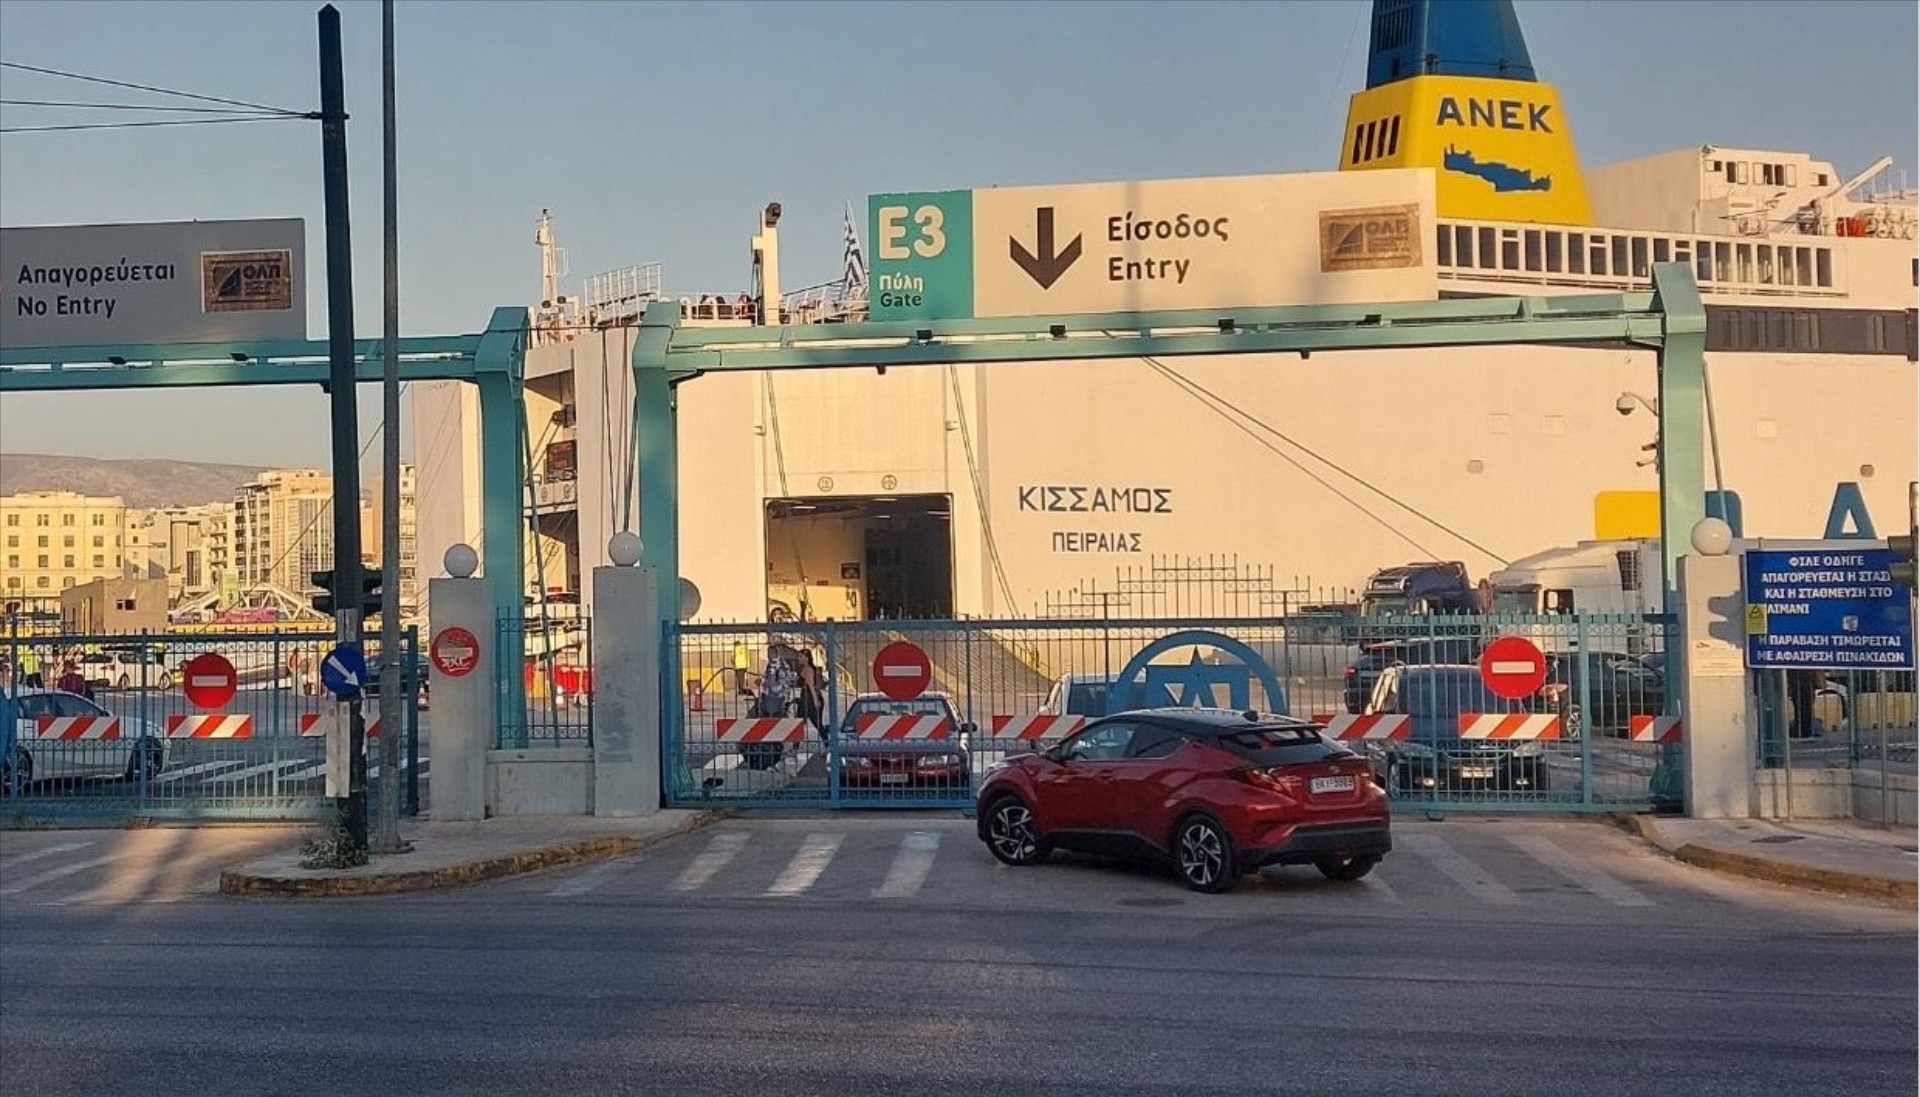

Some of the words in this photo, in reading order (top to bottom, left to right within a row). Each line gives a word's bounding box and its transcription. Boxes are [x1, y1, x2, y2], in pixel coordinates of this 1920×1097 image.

[1436, 97, 1553, 133] ANEK
[879, 205, 946, 260] E3
[1108, 210, 1229, 241] Είσοδος
[18, 257, 174, 288] Απαγορεύεται
[1109, 257, 1190, 284] Entry
[879, 271, 924, 293] Πύλη
[18, 296, 47, 316] No
[57, 295, 116, 318] Entry
[880, 293, 922, 307] Gate
[1019, 486, 1173, 513] ΚΙΣΣΑΜΟΣ
[1052, 532, 1143, 552] ΠΕΙΡΑΙΑΣ
[1789, 556, 1820, 567] ΦΙΛΕ
[1823, 555, 1865, 567] ΟΔΗΓΕ
[1761, 571, 1844, 583] ΑΠΑΓΟΡΕΥΕΤΑΙ
[1848, 571, 1856, 582] Η
[1859, 571, 1893, 582] ΣΤΑΣ
[1764, 588, 1785, 599] ΚΑΙ
[1788, 588, 1797, 599] Η
[1799, 587, 1867, 599] ΣΤΑΘΜΕΥΣΗ
[1869, 586, 1893, 598] ΣΤΟ
[1769, 634, 1829, 646] ΠΑΡΑΒΑΣΗ
[1831, 635, 1902, 647] ΤΙΜΩΡΕΙΤΑΙ
[1756, 651, 1774, 661] ΜΕ
[1776, 650, 1833, 661] ΑΦΑΙΡΕΣΗ
[1836, 651, 1904, 663] ΠΙΝΑΚΙΔΩΝ
